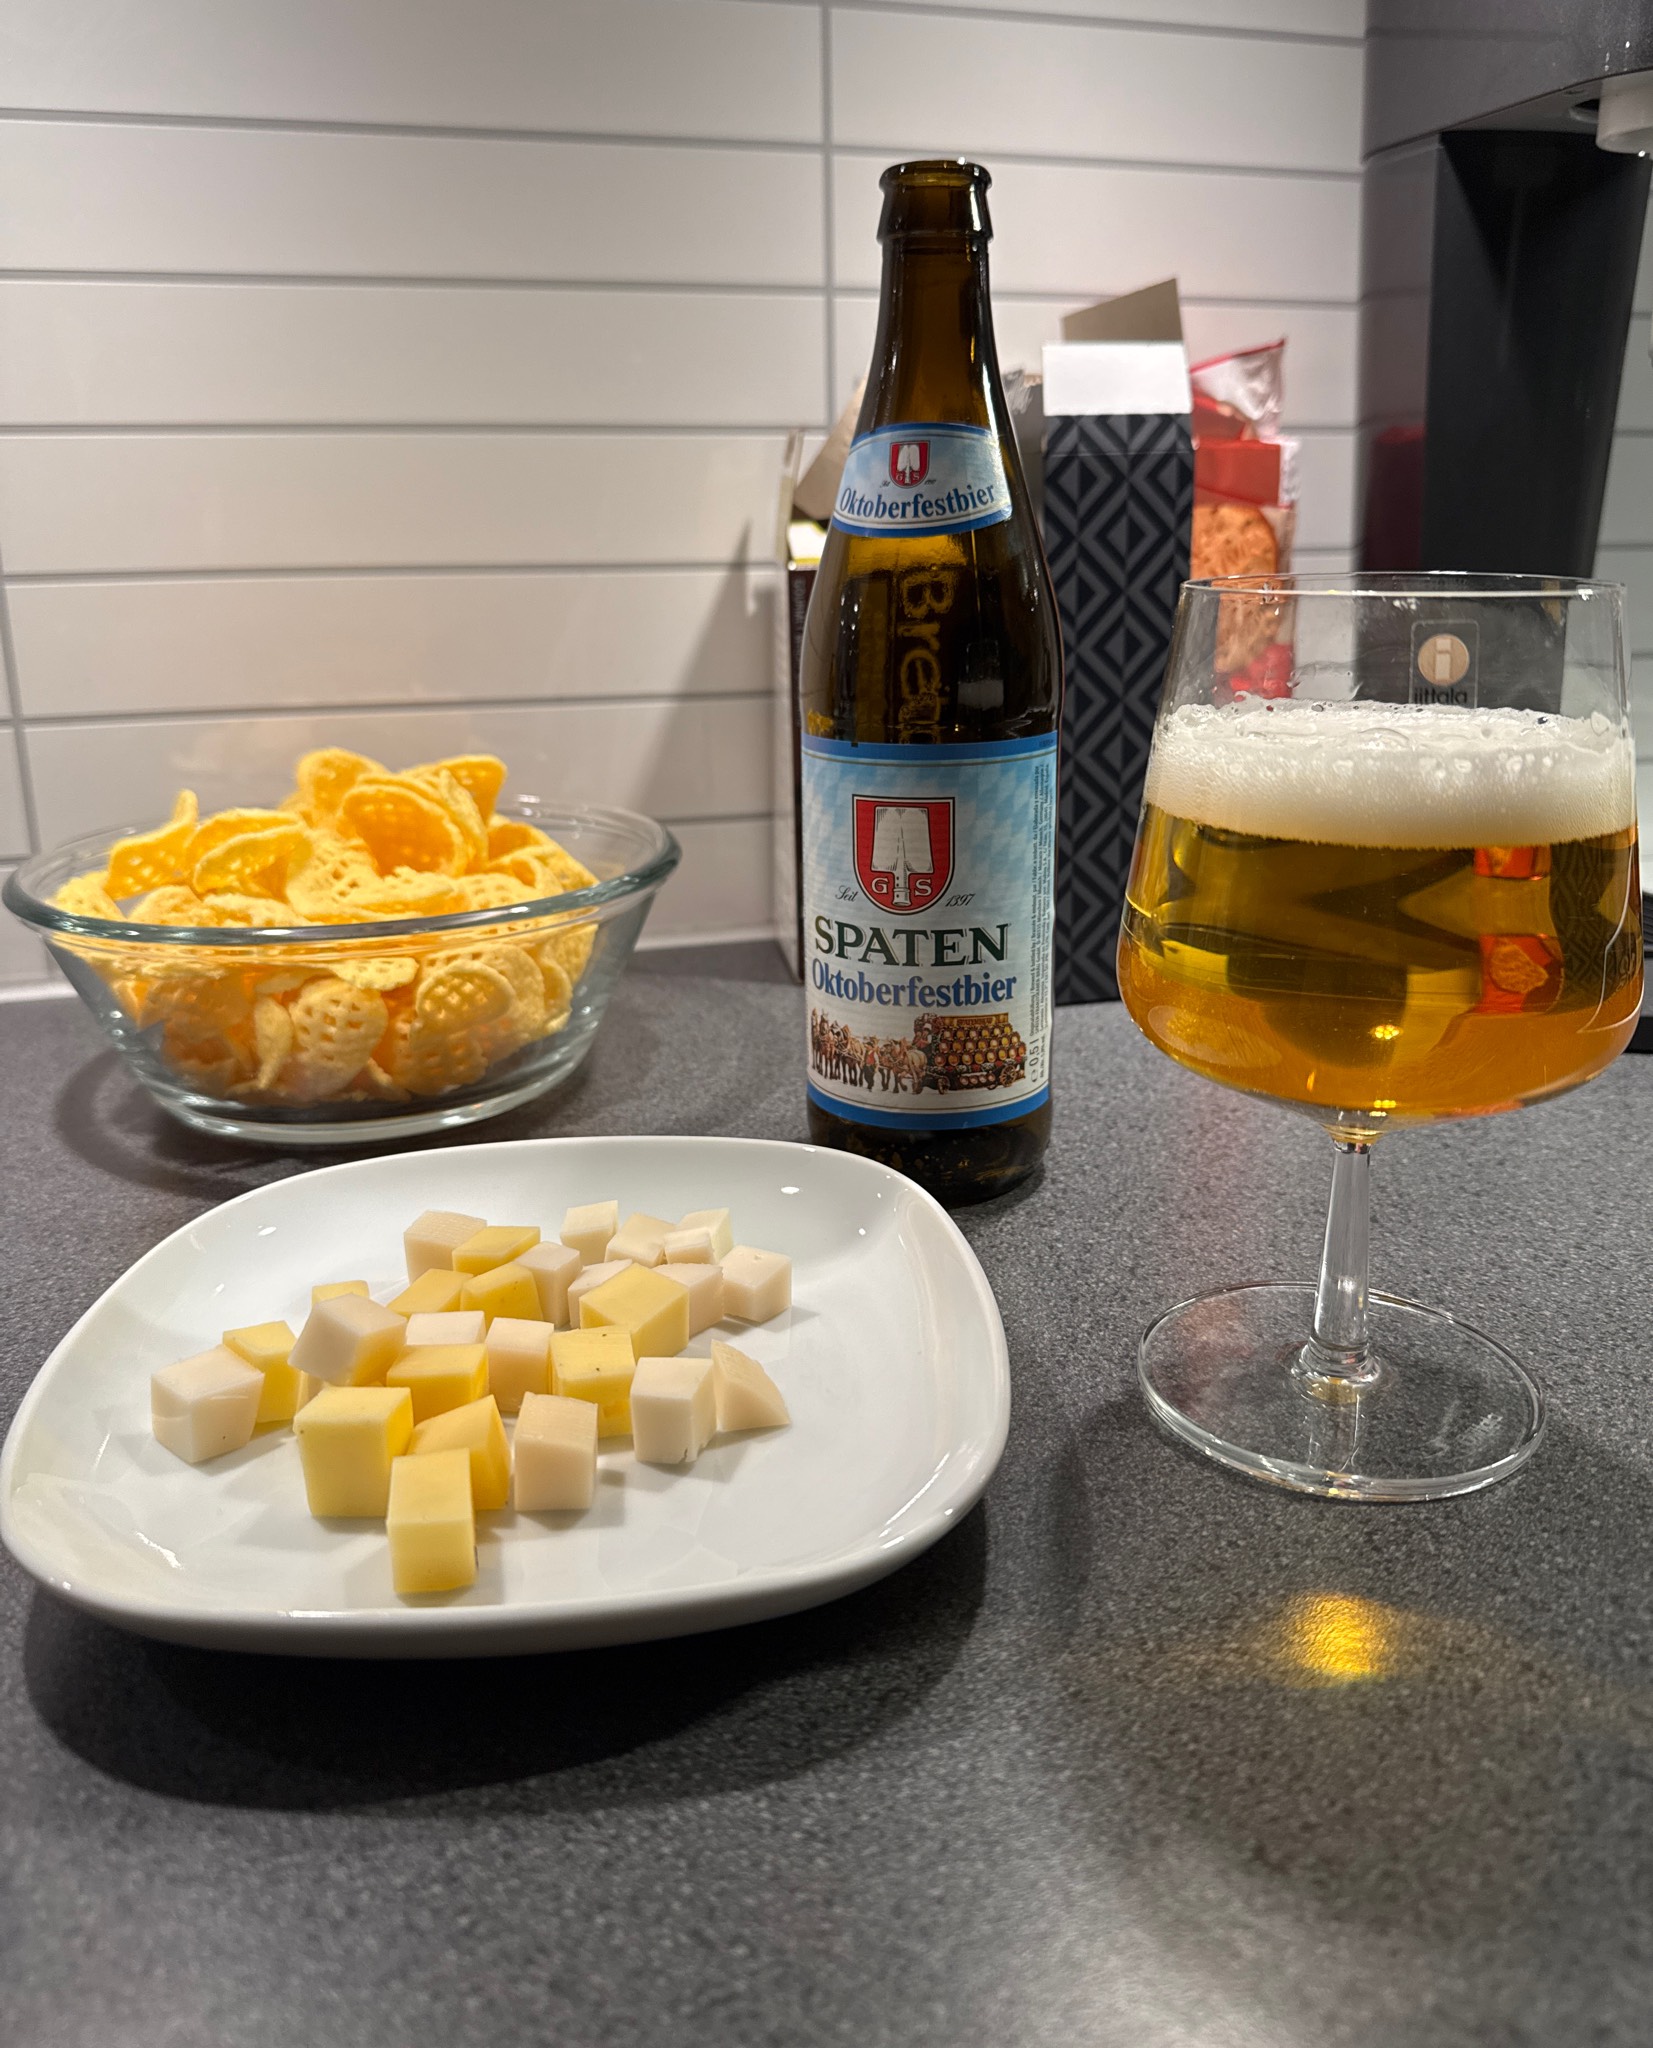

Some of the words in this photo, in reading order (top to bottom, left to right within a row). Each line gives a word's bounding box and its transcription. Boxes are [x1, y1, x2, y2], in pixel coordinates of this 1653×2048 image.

[839, 484, 996, 520] Oktoberfestbier
[1414, 687, 1468, 704] iittala
[835, 885, 858, 903] Seit
[945, 892, 976, 908] 1397
[871, 877, 889, 895] G
[915, 878, 932, 896] S
[814, 915, 1010, 968] SPATEN
[812, 957, 1017, 1008] Oktoberfestbier
